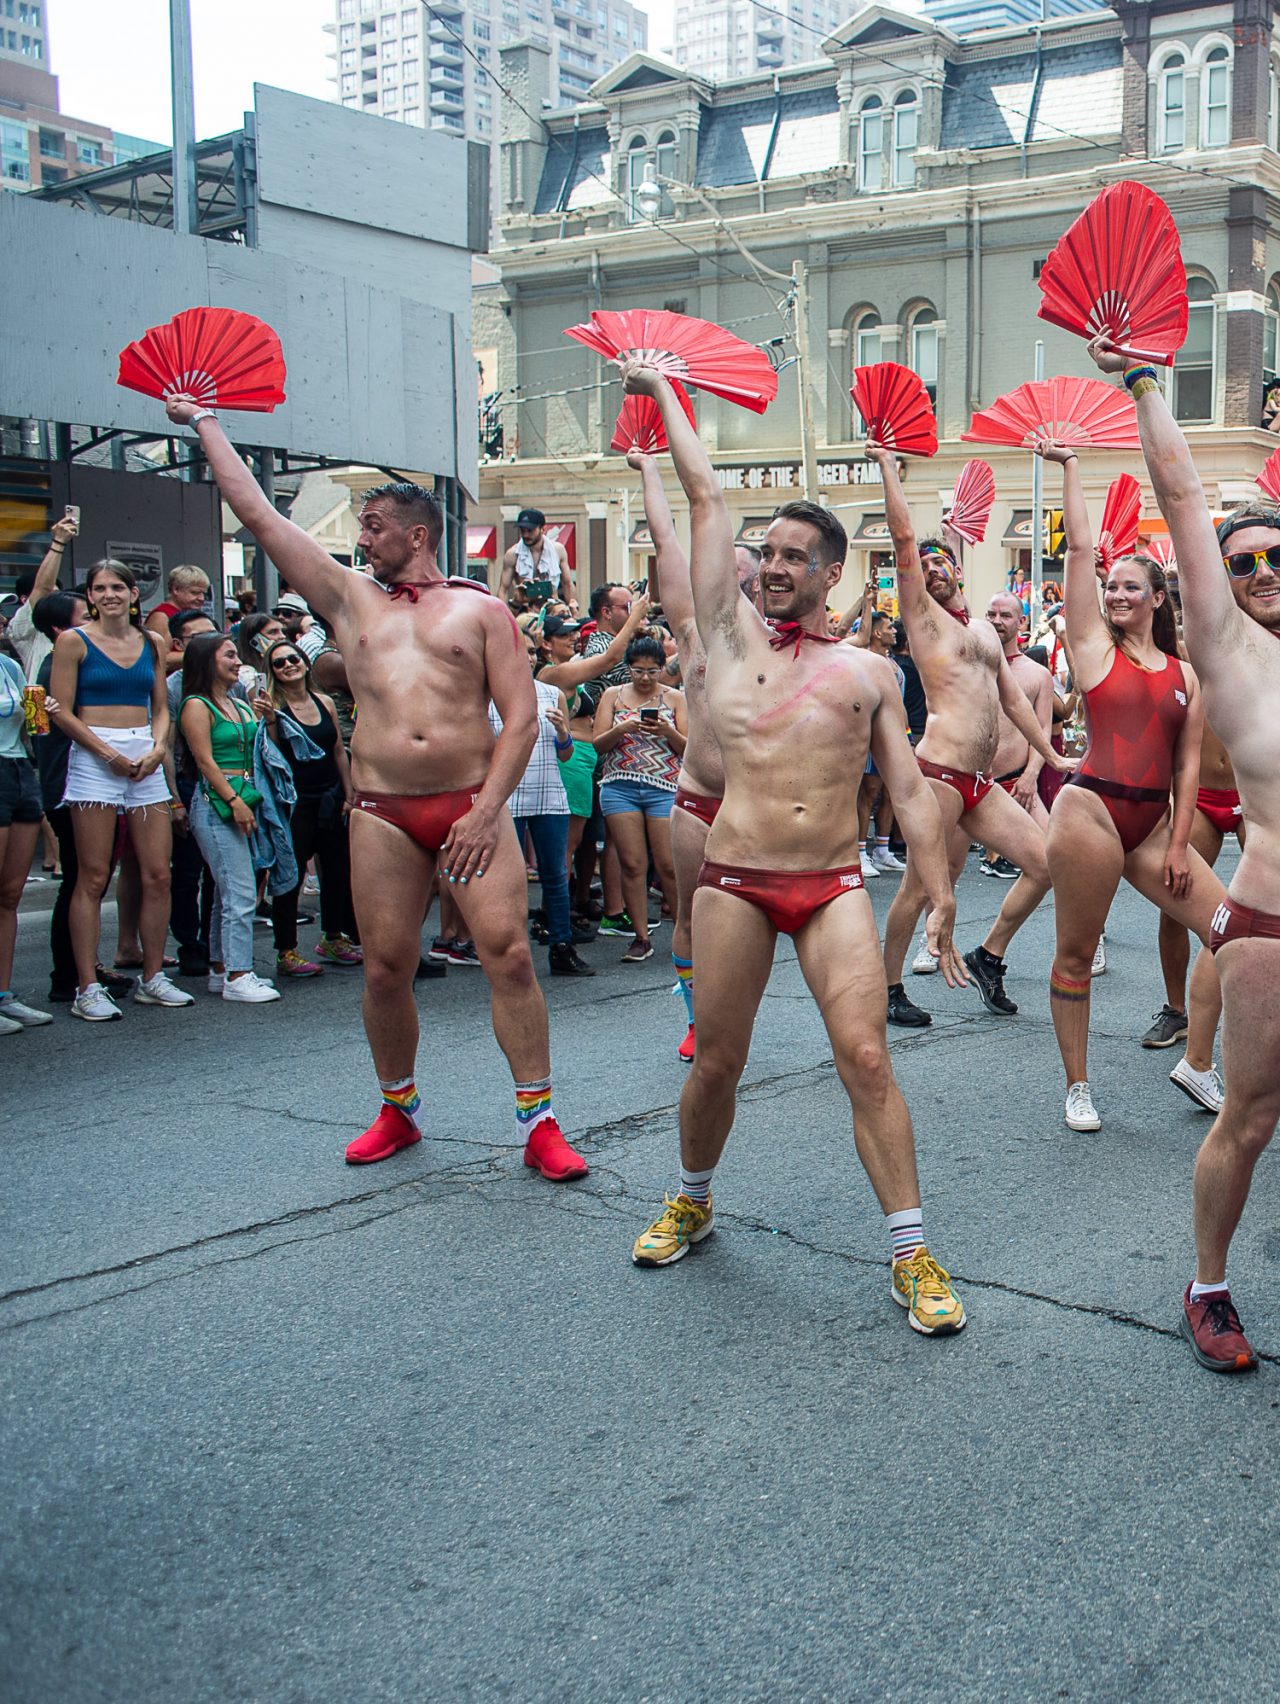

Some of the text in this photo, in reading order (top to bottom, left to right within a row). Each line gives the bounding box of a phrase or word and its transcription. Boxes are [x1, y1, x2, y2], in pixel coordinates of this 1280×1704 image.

[749, 467, 766, 489] OF
[768, 466, 794, 488] THE
[798, 463, 849, 487] BRGER
[853, 461, 901, 485] FAM
[127, 562, 161, 576] SG
